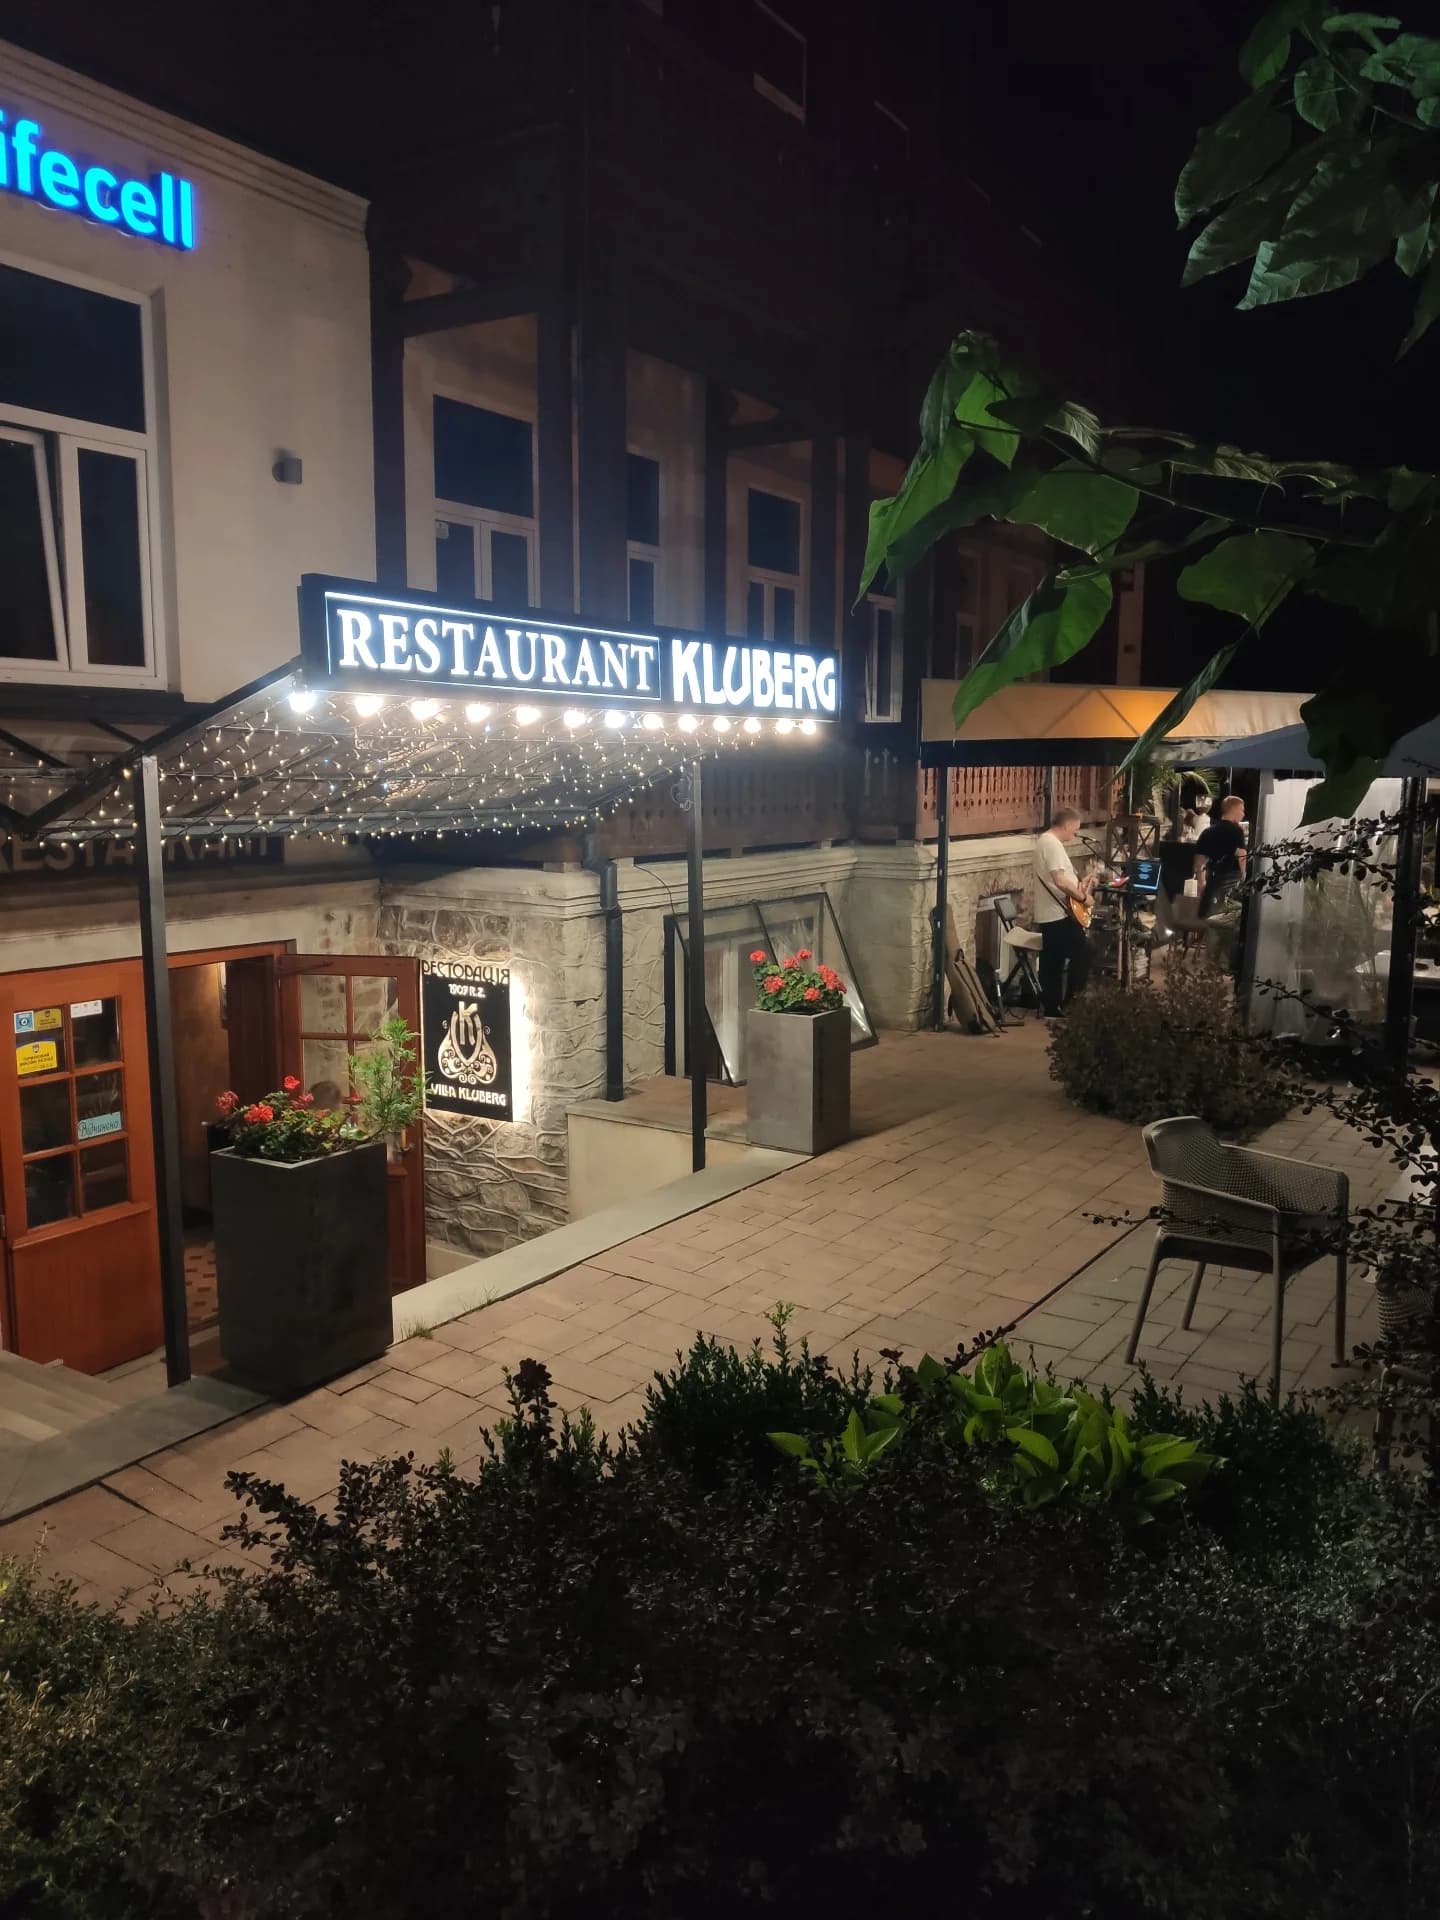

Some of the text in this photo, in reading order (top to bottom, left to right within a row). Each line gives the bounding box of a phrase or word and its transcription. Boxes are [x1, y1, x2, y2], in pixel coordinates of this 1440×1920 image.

[336, 608, 837, 712] RESTAURANT KLUBERG
[422, 960, 510, 985] РЕСТОРАЦІЯ
[458, 1087, 507, 1106] KLUBERG
